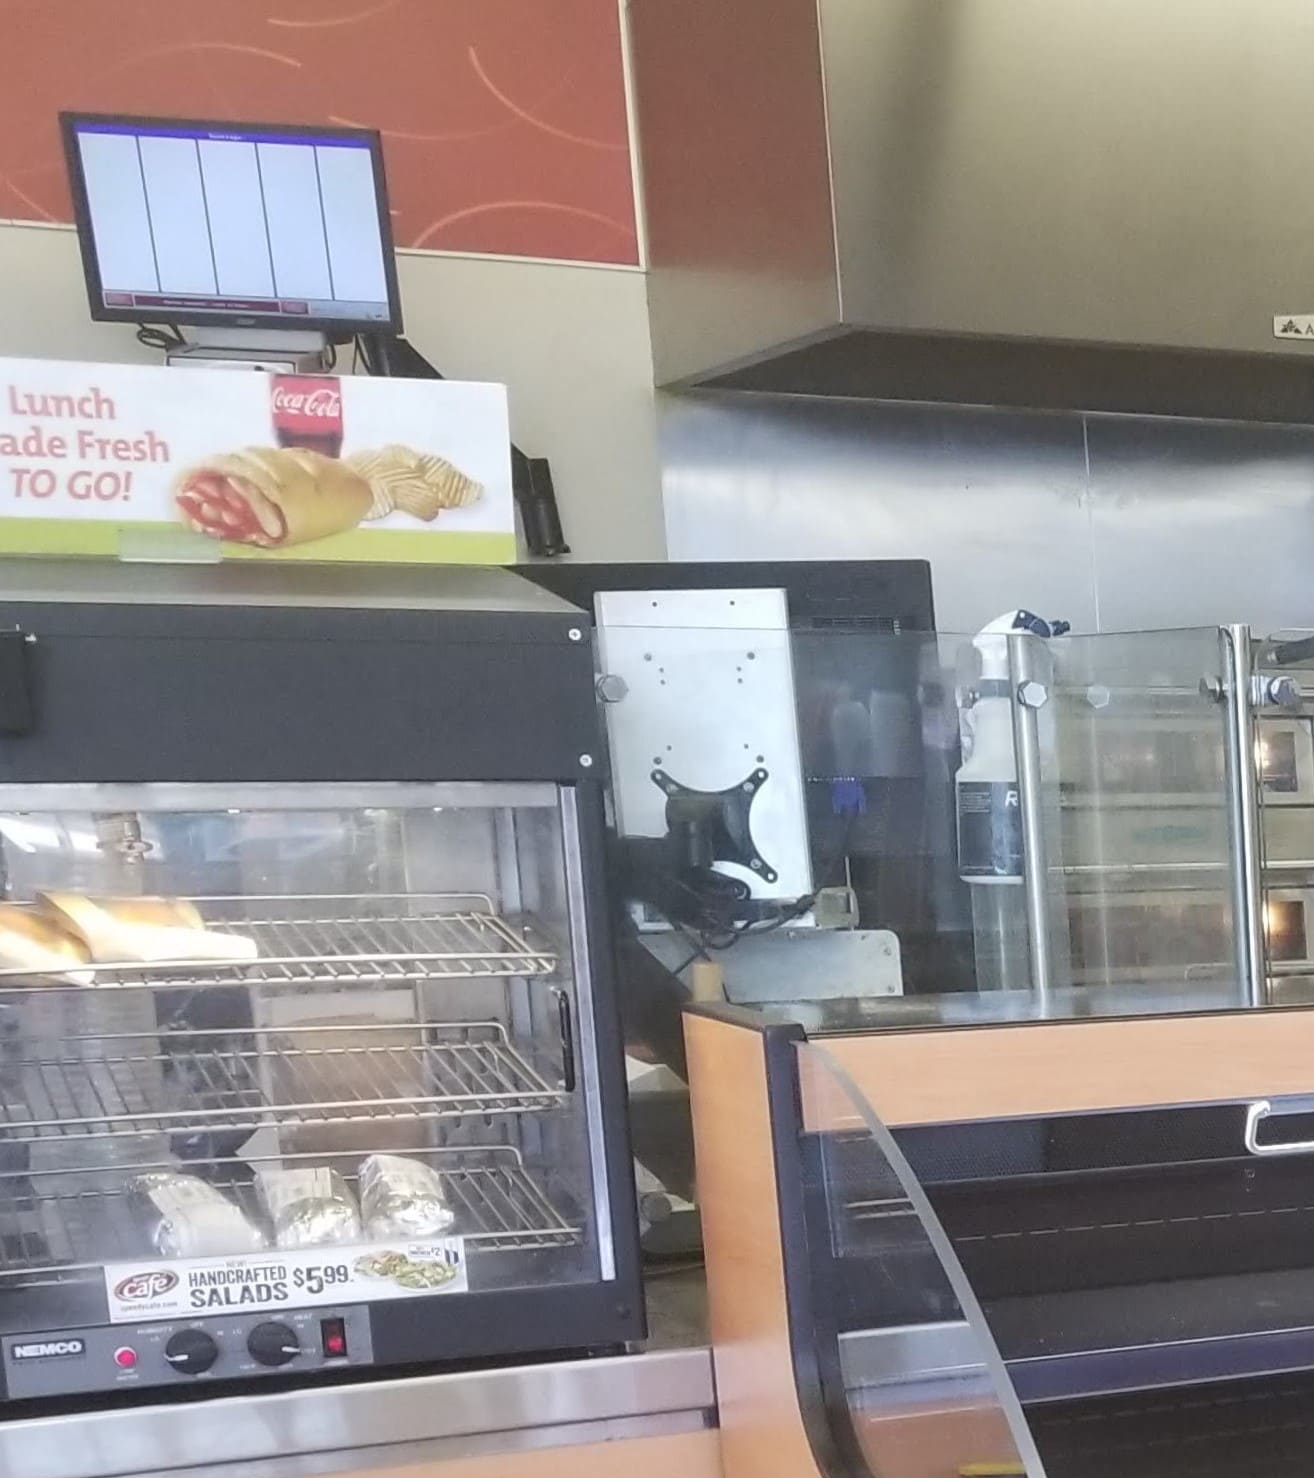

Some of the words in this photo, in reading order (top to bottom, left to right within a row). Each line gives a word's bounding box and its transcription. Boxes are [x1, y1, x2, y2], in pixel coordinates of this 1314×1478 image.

[9, 385, 116, 420] Lunch
[0, 427, 66, 458] ade
[76, 430, 170, 463] Fresh
[10, 468, 57, 498] TO
[67, 470, 132, 501] GO!
[188, 1266, 287, 1288] HANDCRAFTED
[190, 1282, 289, 1309] SALADS
[14, 1340, 82, 1358] NEMCO
